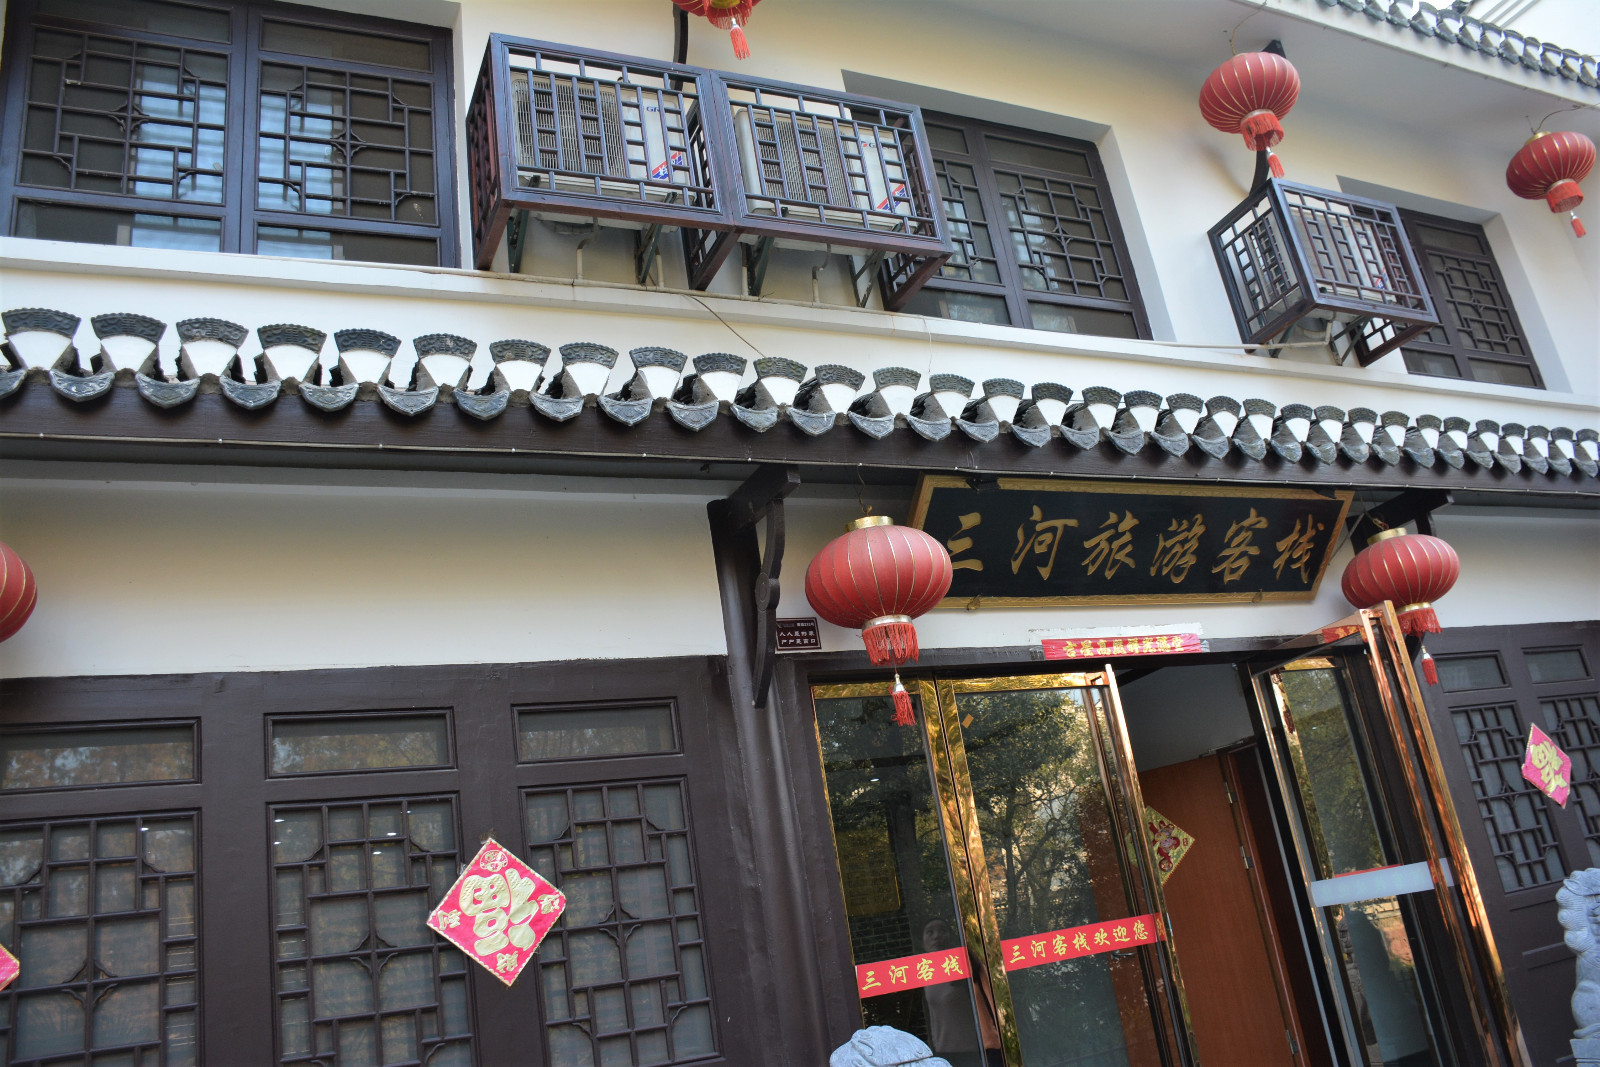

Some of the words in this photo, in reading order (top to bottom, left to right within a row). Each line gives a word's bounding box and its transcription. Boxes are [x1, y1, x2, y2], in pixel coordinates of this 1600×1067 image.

[946, 504, 1325, 585] 三河旅游客栈
[459, 868, 540, 957] 福
[1009, 919, 1149, 964] 三河客栈欢迎您
[861, 953, 964, 991] 三河客栈
